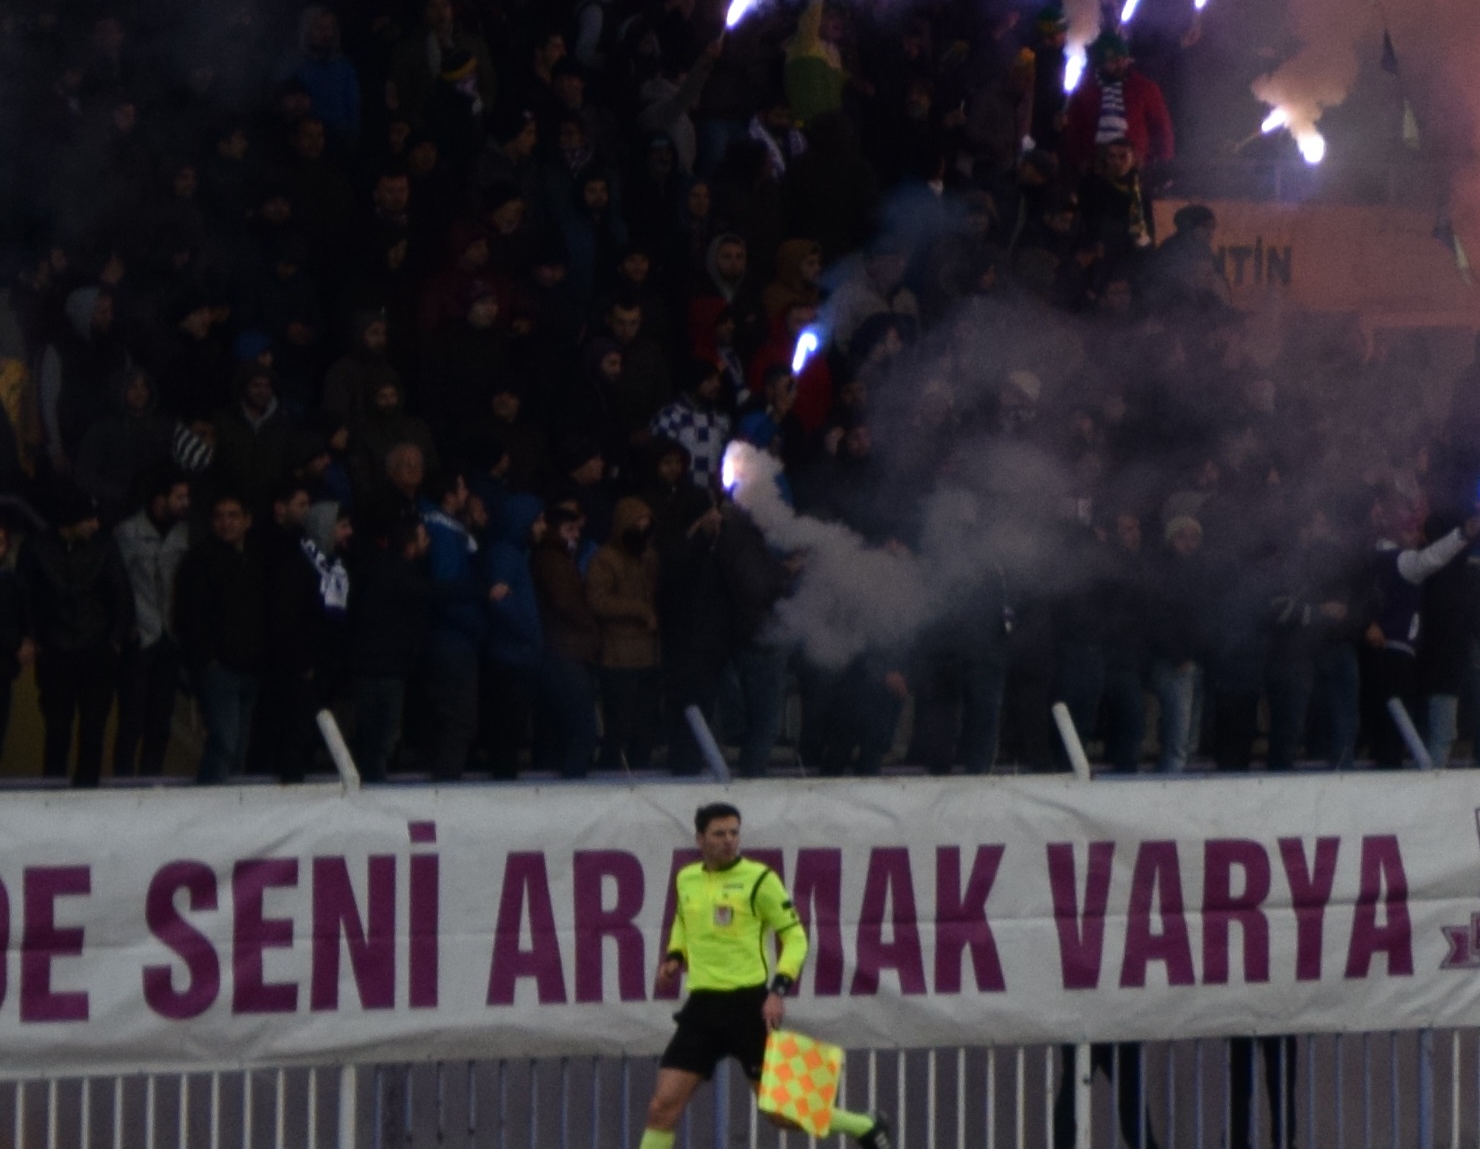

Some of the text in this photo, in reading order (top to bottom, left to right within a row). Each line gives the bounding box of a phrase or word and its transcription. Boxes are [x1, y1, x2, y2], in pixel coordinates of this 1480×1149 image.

[0, 864, 91, 1023] E
[142, 820, 439, 1021] SENİ
[1046, 834, 1416, 991] VARYA
